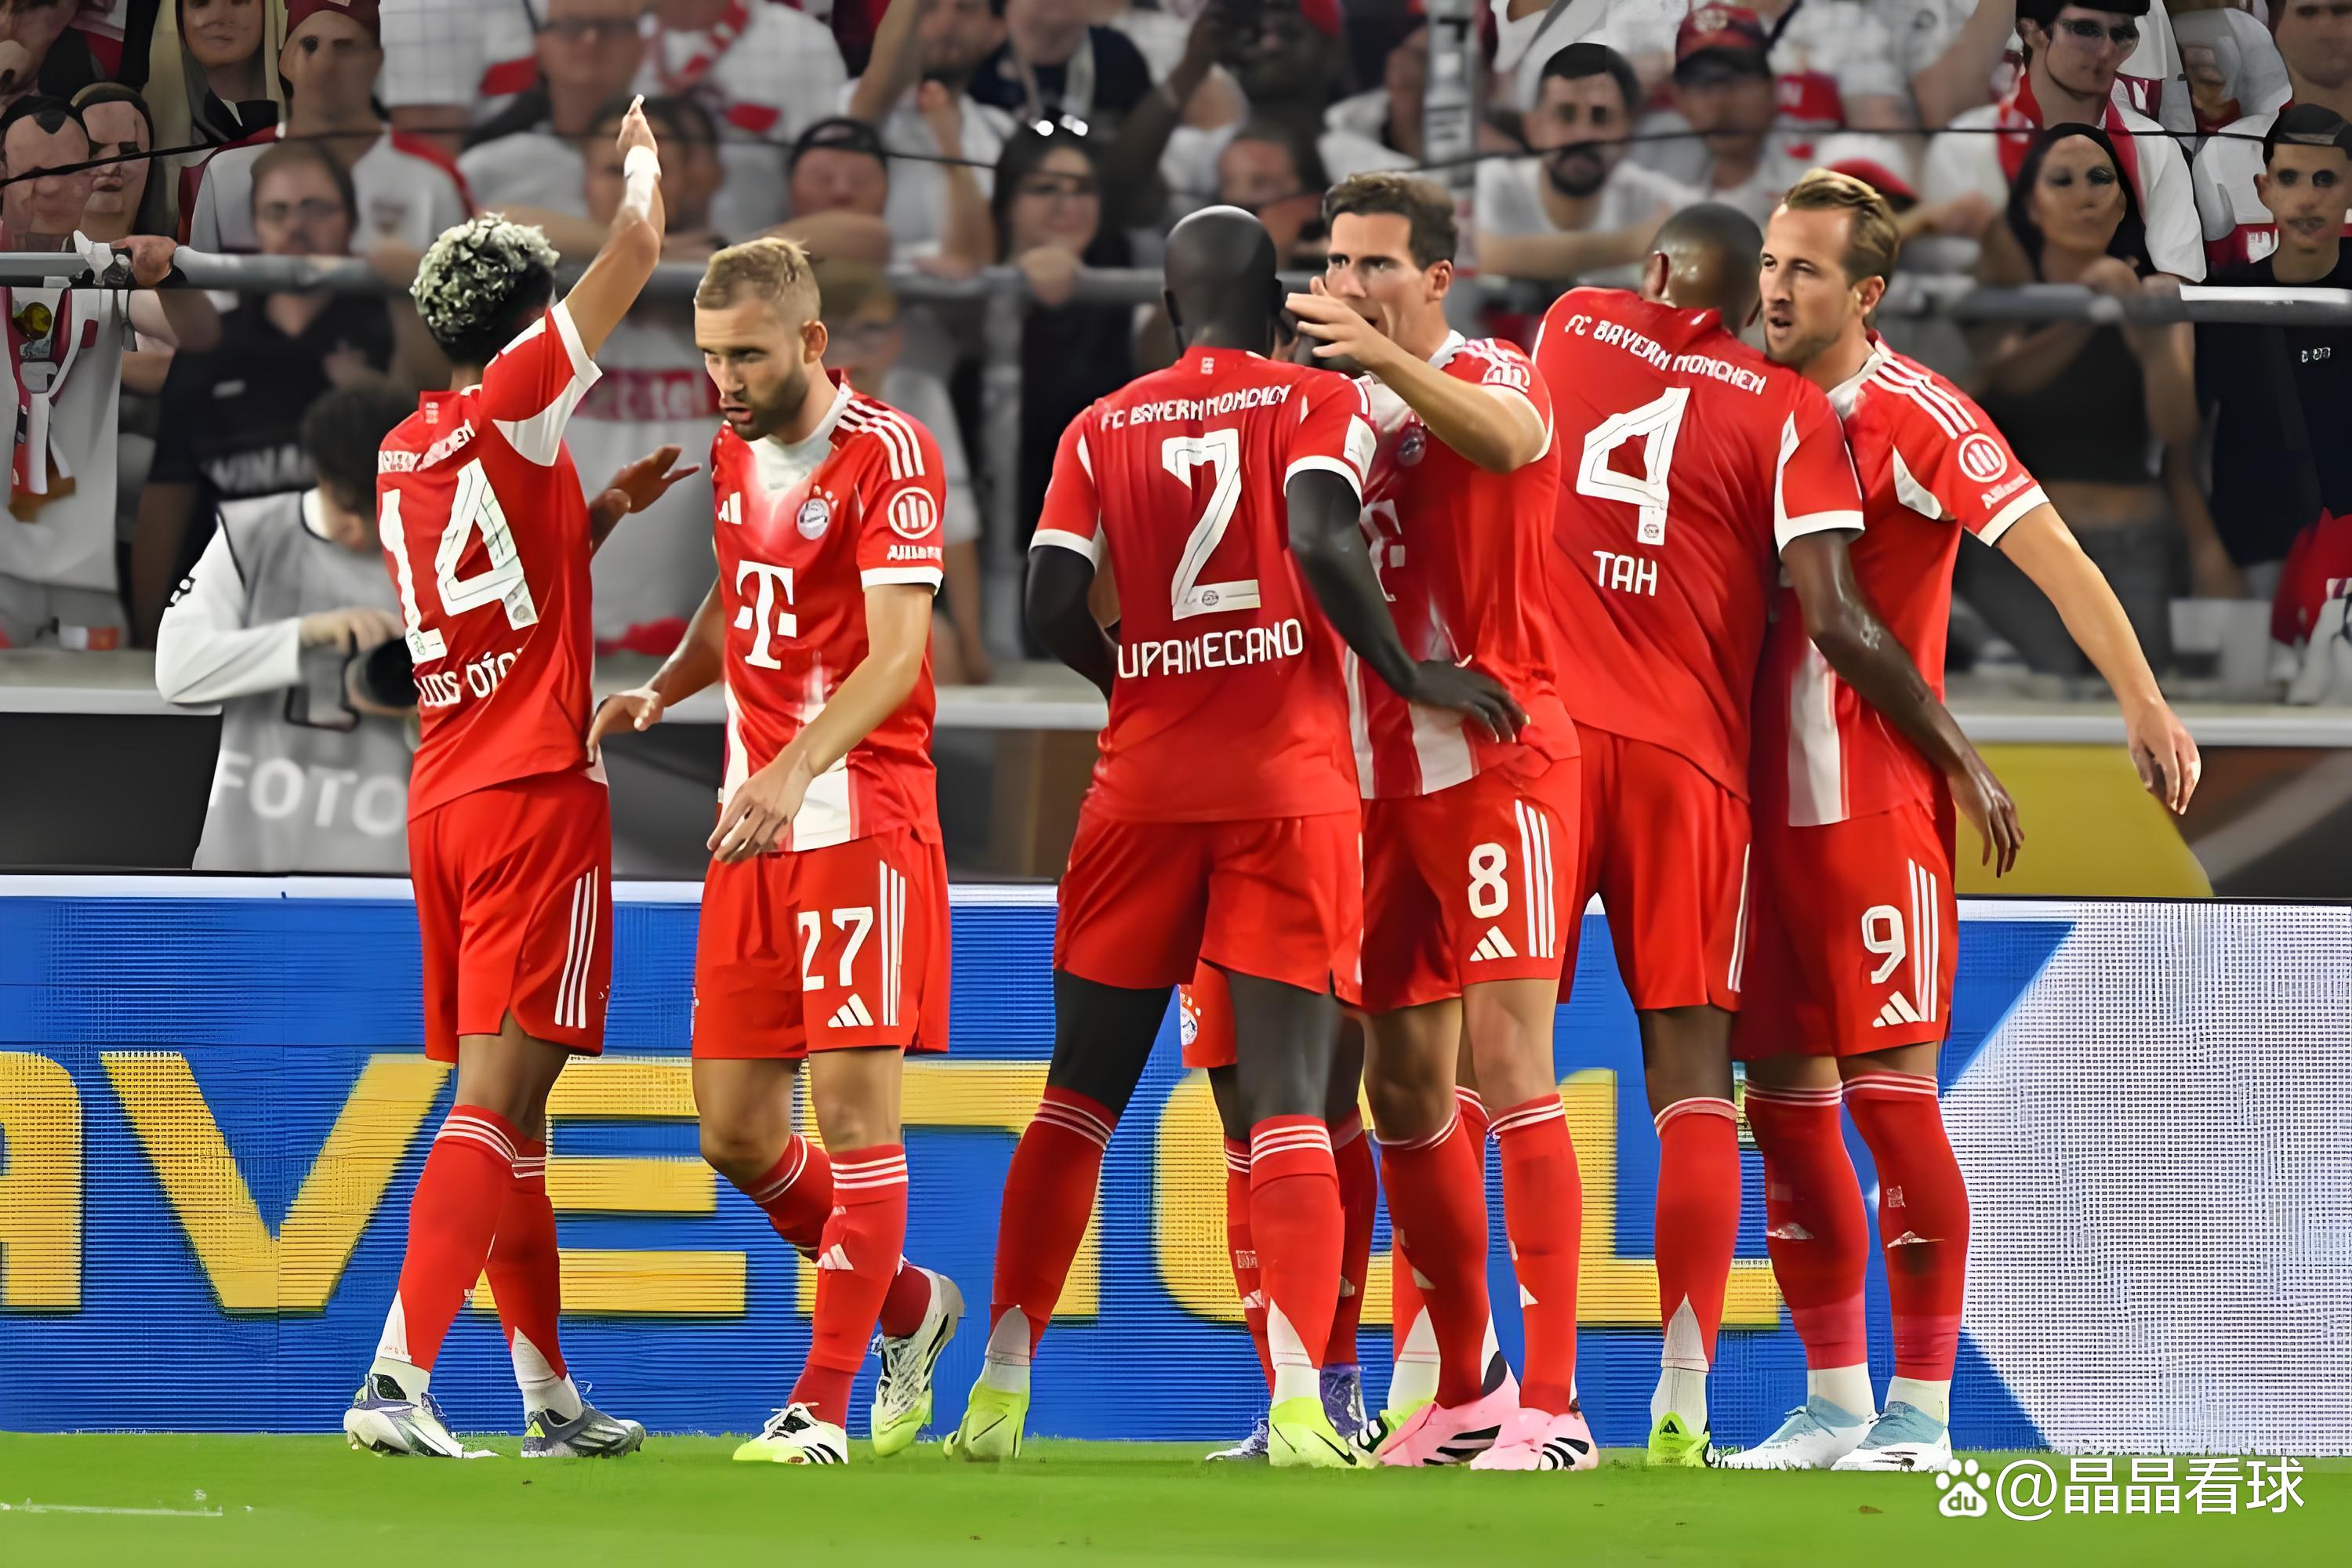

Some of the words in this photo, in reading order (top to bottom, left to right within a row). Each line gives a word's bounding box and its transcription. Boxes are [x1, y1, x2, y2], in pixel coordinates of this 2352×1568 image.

[1576, 387, 1691, 546] 4
[379, 456, 540, 663] 14
[1161, 427, 1261, 622] 2
[1592, 550, 1658, 597] TAH
[1117, 618, 1304, 679] UPAMECANO
[207, 748, 408, 837] FOTO
[1467, 842, 1509, 919] 8
[797, 906, 875, 992] 27
[1860, 904, 1907, 984] 9
